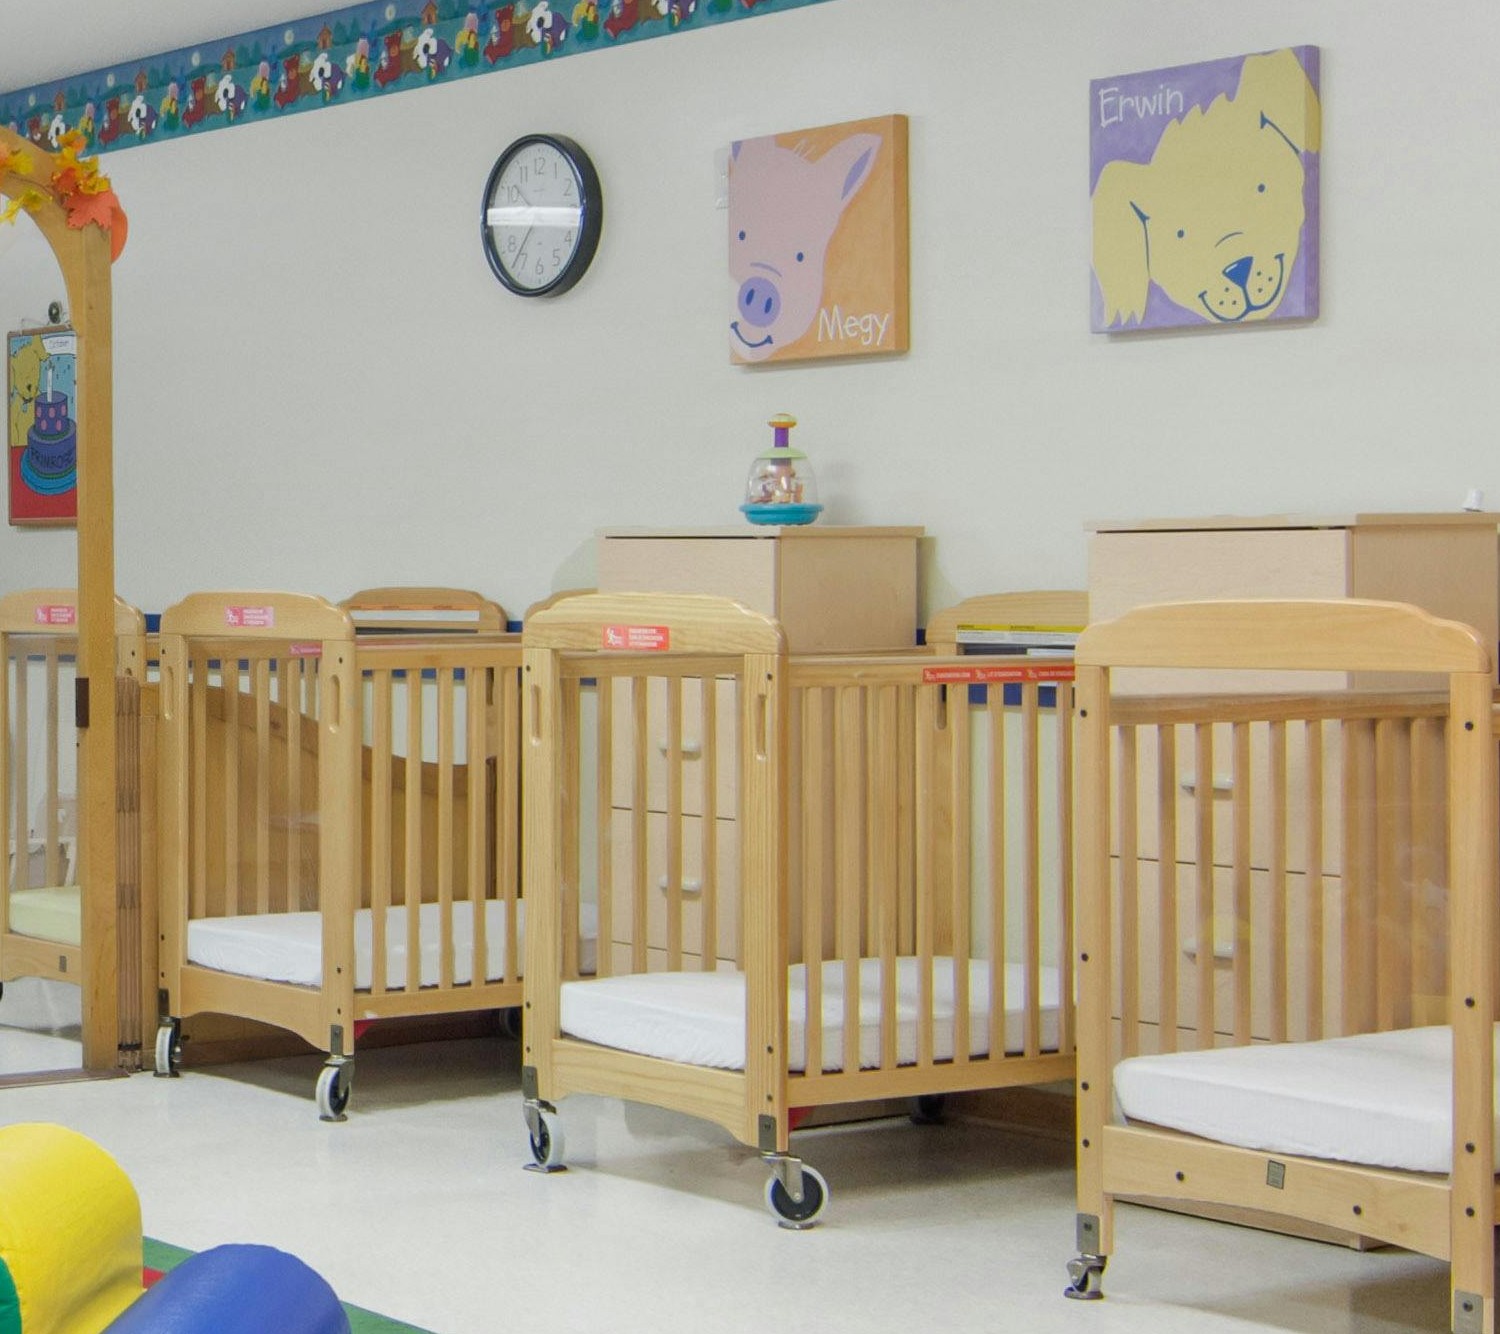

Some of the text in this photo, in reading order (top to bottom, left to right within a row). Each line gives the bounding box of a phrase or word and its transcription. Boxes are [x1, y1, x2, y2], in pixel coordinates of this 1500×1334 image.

[1099, 84, 1184, 128] Erwin
[519, 165, 528, 184] 11
[534, 157, 546, 176] 12
[507, 185, 519, 203] 10
[563, 178, 572, 197] 2
[508, 235, 517, 253] 8
[564, 230, 572, 248] 4
[520, 253, 528, 270] 7
[535, 257, 544, 276] 6
[552, 248, 561, 267] 5
[817, 304, 890, 346] Megy
